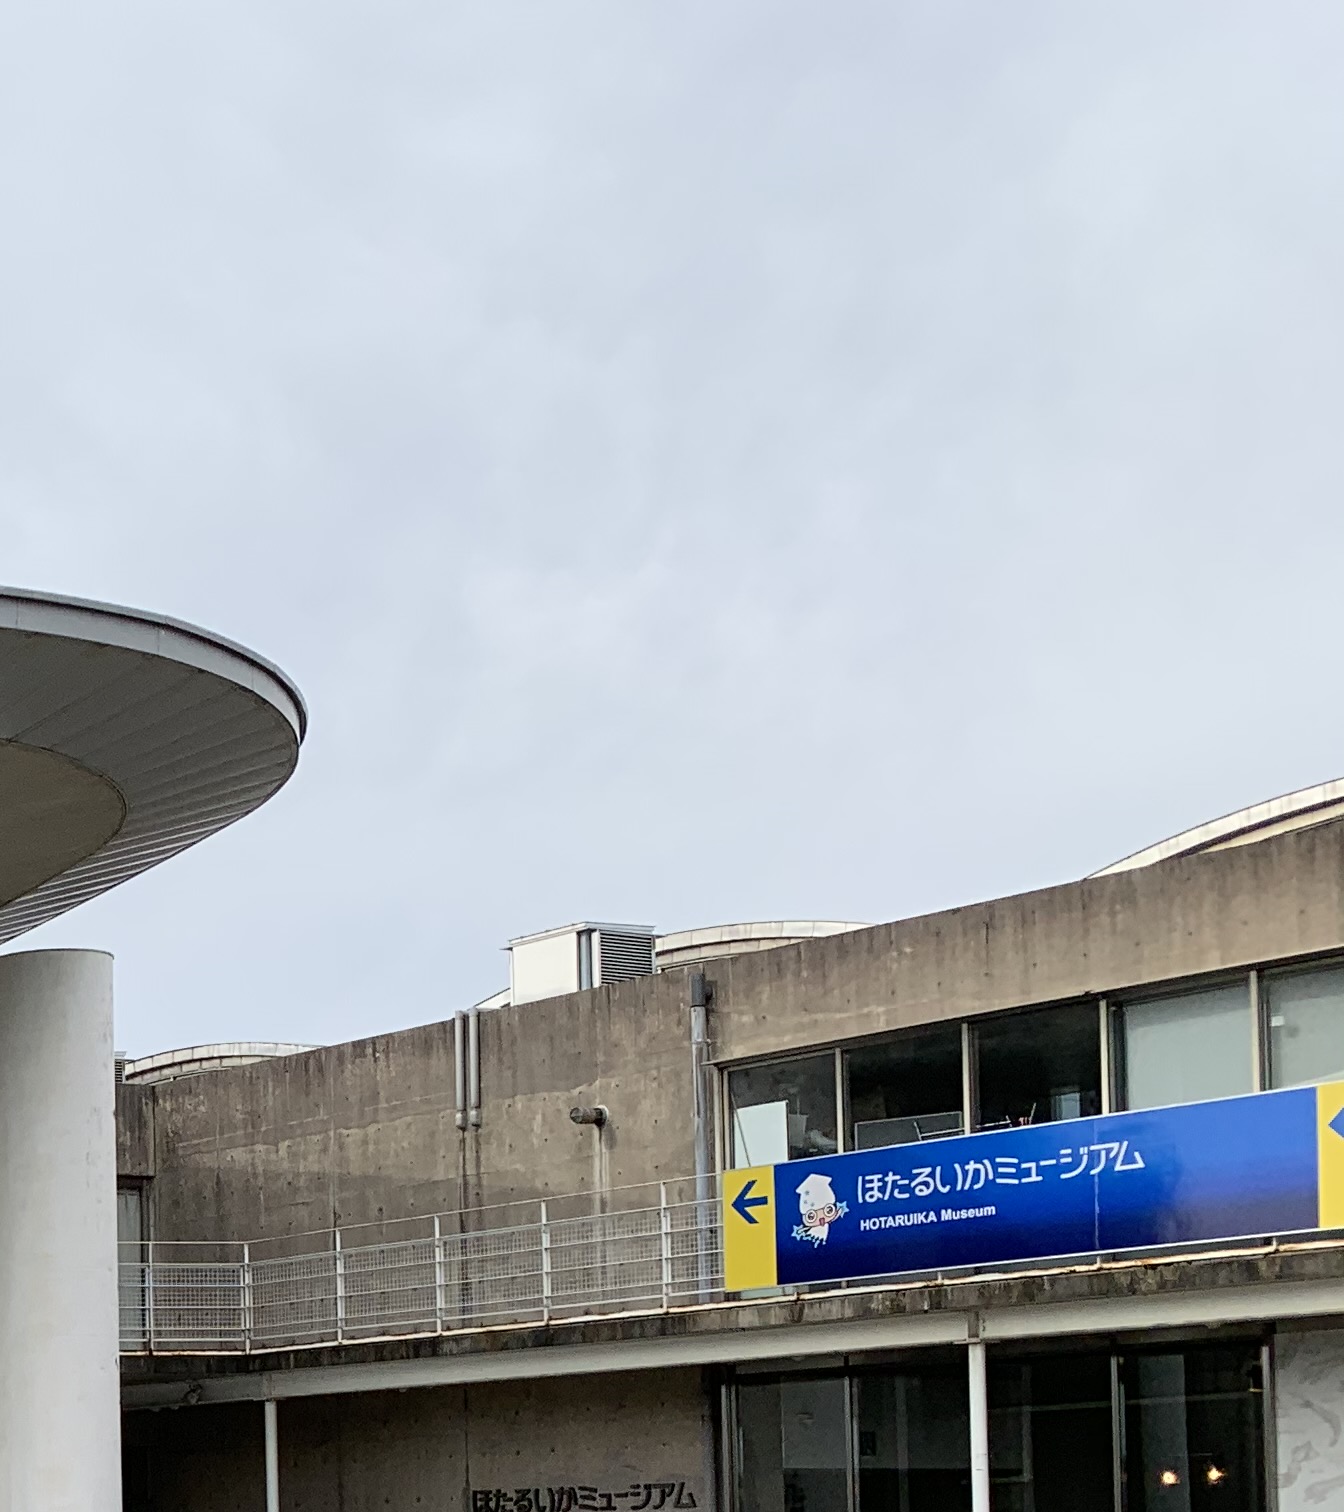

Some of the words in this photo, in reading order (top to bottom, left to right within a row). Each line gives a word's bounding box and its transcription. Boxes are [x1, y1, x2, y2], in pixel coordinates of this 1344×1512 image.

[857, 1140, 1145, 1204] ほたるいかミュージアム
[860, 1209, 938, 1231] HOTARUIKA
[940, 1205, 996, 1222] Museum
